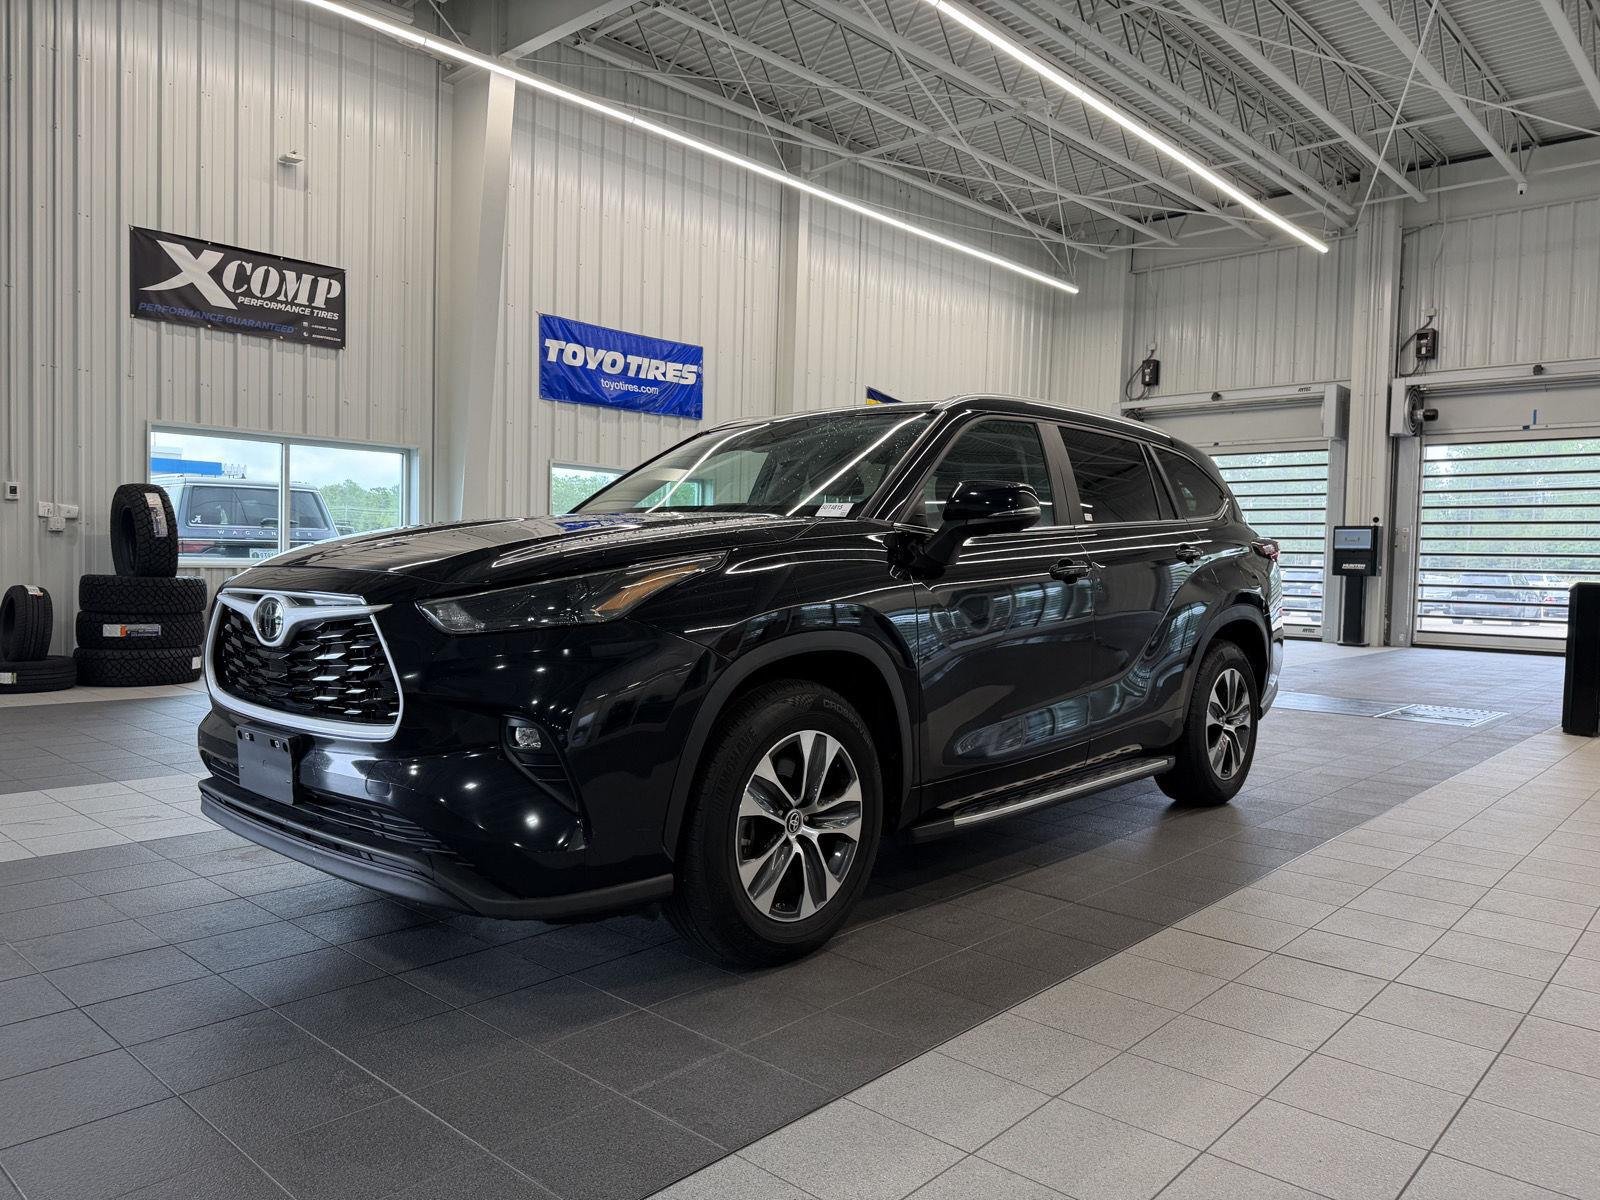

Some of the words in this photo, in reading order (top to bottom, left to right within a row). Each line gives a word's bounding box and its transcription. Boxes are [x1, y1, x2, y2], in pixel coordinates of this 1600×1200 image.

[138, 302, 225, 323] PERFORMANCE
[225, 315, 295, 334] GUARANTEED
[237, 296, 312, 316] PERFORMANCE
[313, 309, 340, 321] TIRES
[600, 378, 659, 395] toyotires.com
[217, 529, 312, 537] WAGONER
